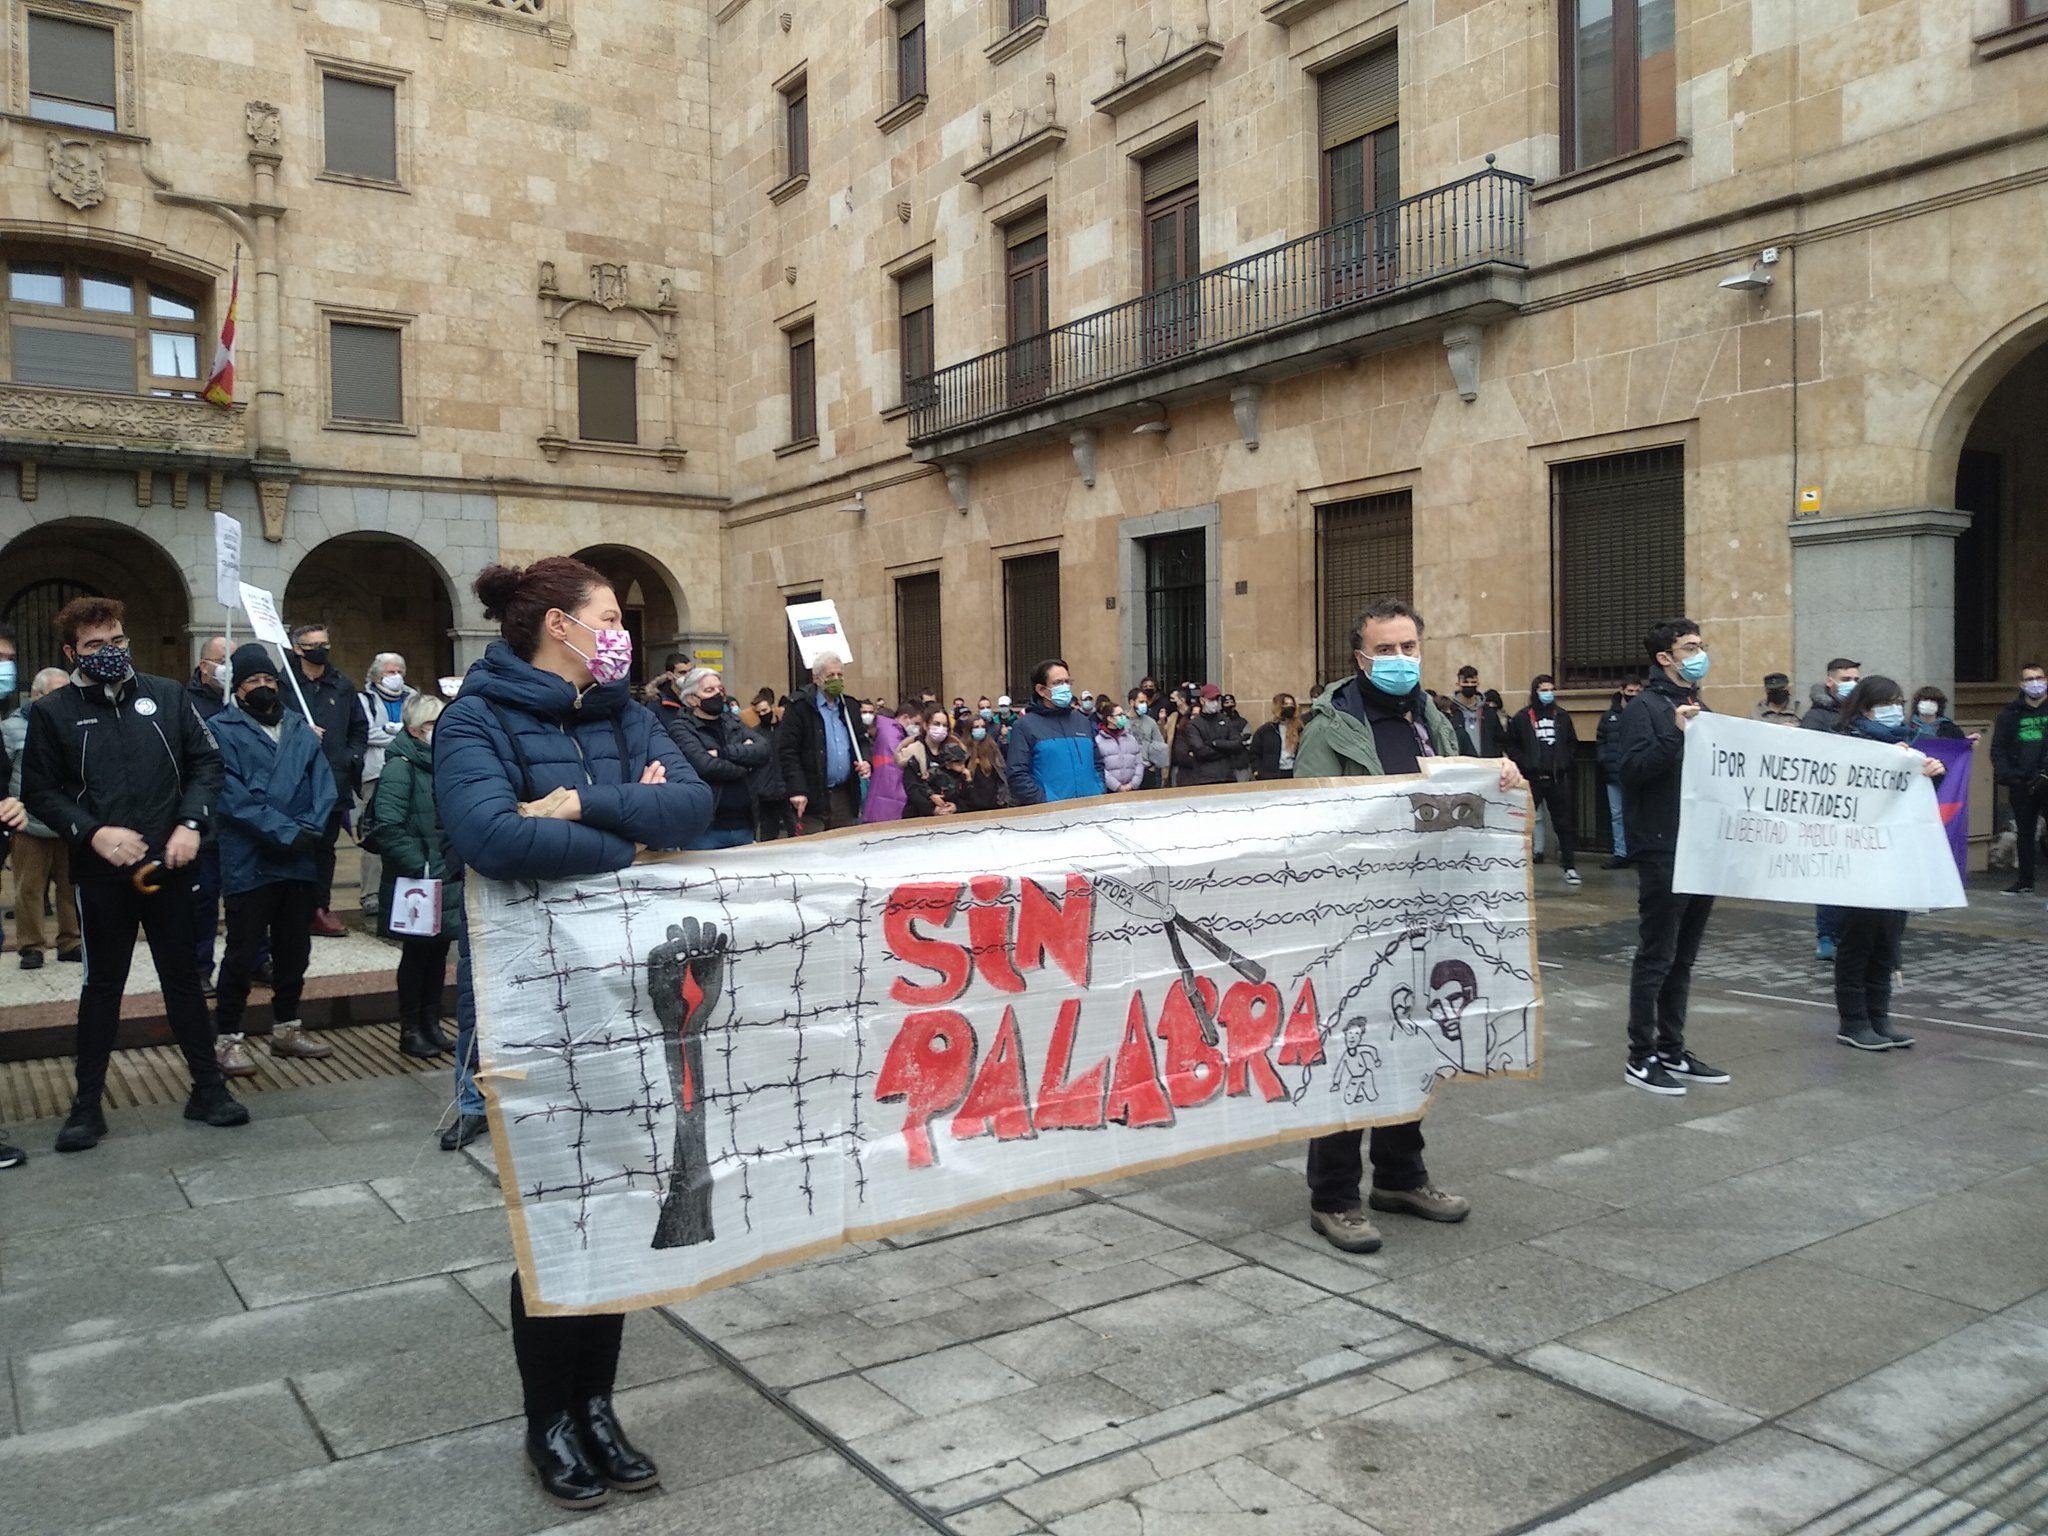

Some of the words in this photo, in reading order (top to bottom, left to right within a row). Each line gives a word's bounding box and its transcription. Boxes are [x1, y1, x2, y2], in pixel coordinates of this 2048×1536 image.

[1711, 742, 1746, 778] ¡POR
[1759, 754, 1838, 786] NUESTROS
[1846, 764, 1912, 793] DERECHOS
[1743, 786, 1755, 813] Y
[1764, 786, 1859, 823] LIBERTADES!
[1798, 821, 1838, 848] PABLO
[875, 975, 1328, 1170] PALABRA
